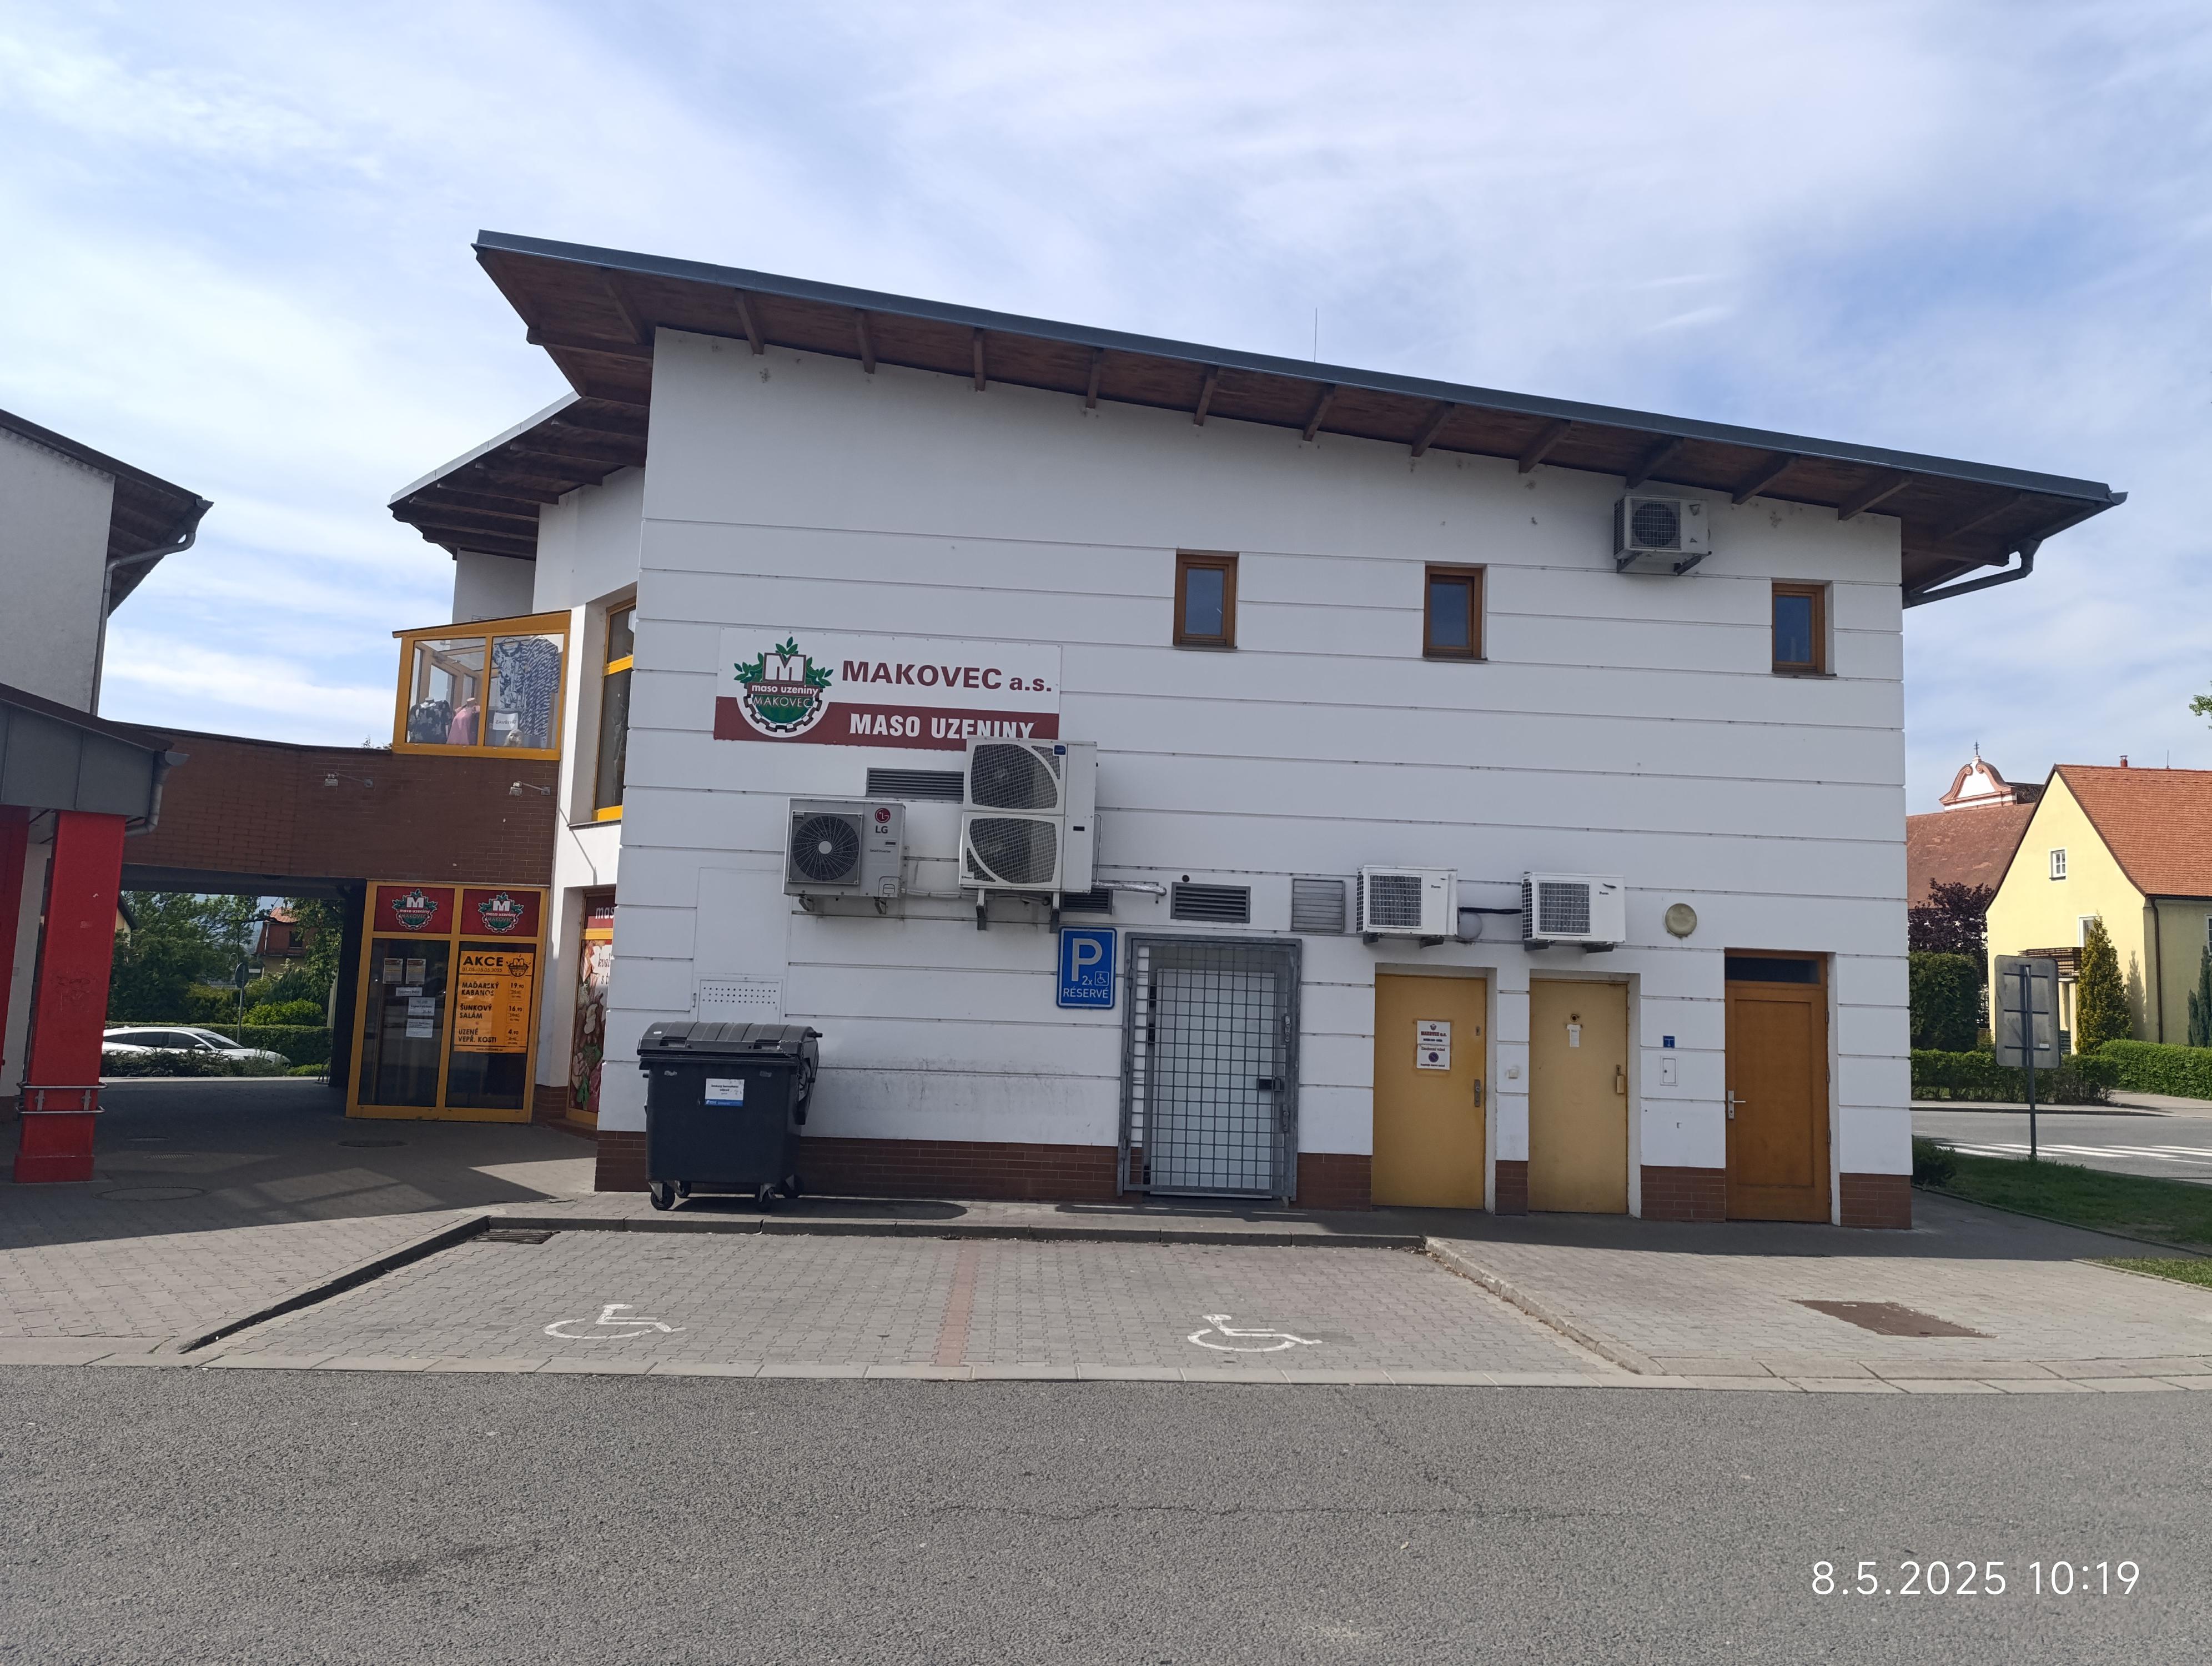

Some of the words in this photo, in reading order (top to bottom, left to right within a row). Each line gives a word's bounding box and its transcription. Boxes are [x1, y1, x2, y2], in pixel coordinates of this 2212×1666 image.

[764, 653, 806, 683] M
[842, 660, 1002, 690] MAKOVEC
[1009, 677, 1052, 692] a.s.
[781, 685, 819, 697] uzeniny
[753, 696, 811, 707] MAKOVEC
[849, 713, 921, 737] MASO
[931, 717, 1036, 739] UZENINY
[875, 825, 888, 834] LG
[462, 956, 504, 966] AKCE
[1072, 937, 1103, 982] P
[1082, 975, 1093, 986] 2x
[1063, 986, 1109, 998] RÉSERVÉ
[460, 1003, 492, 1011] ŠUNKOVÝ
